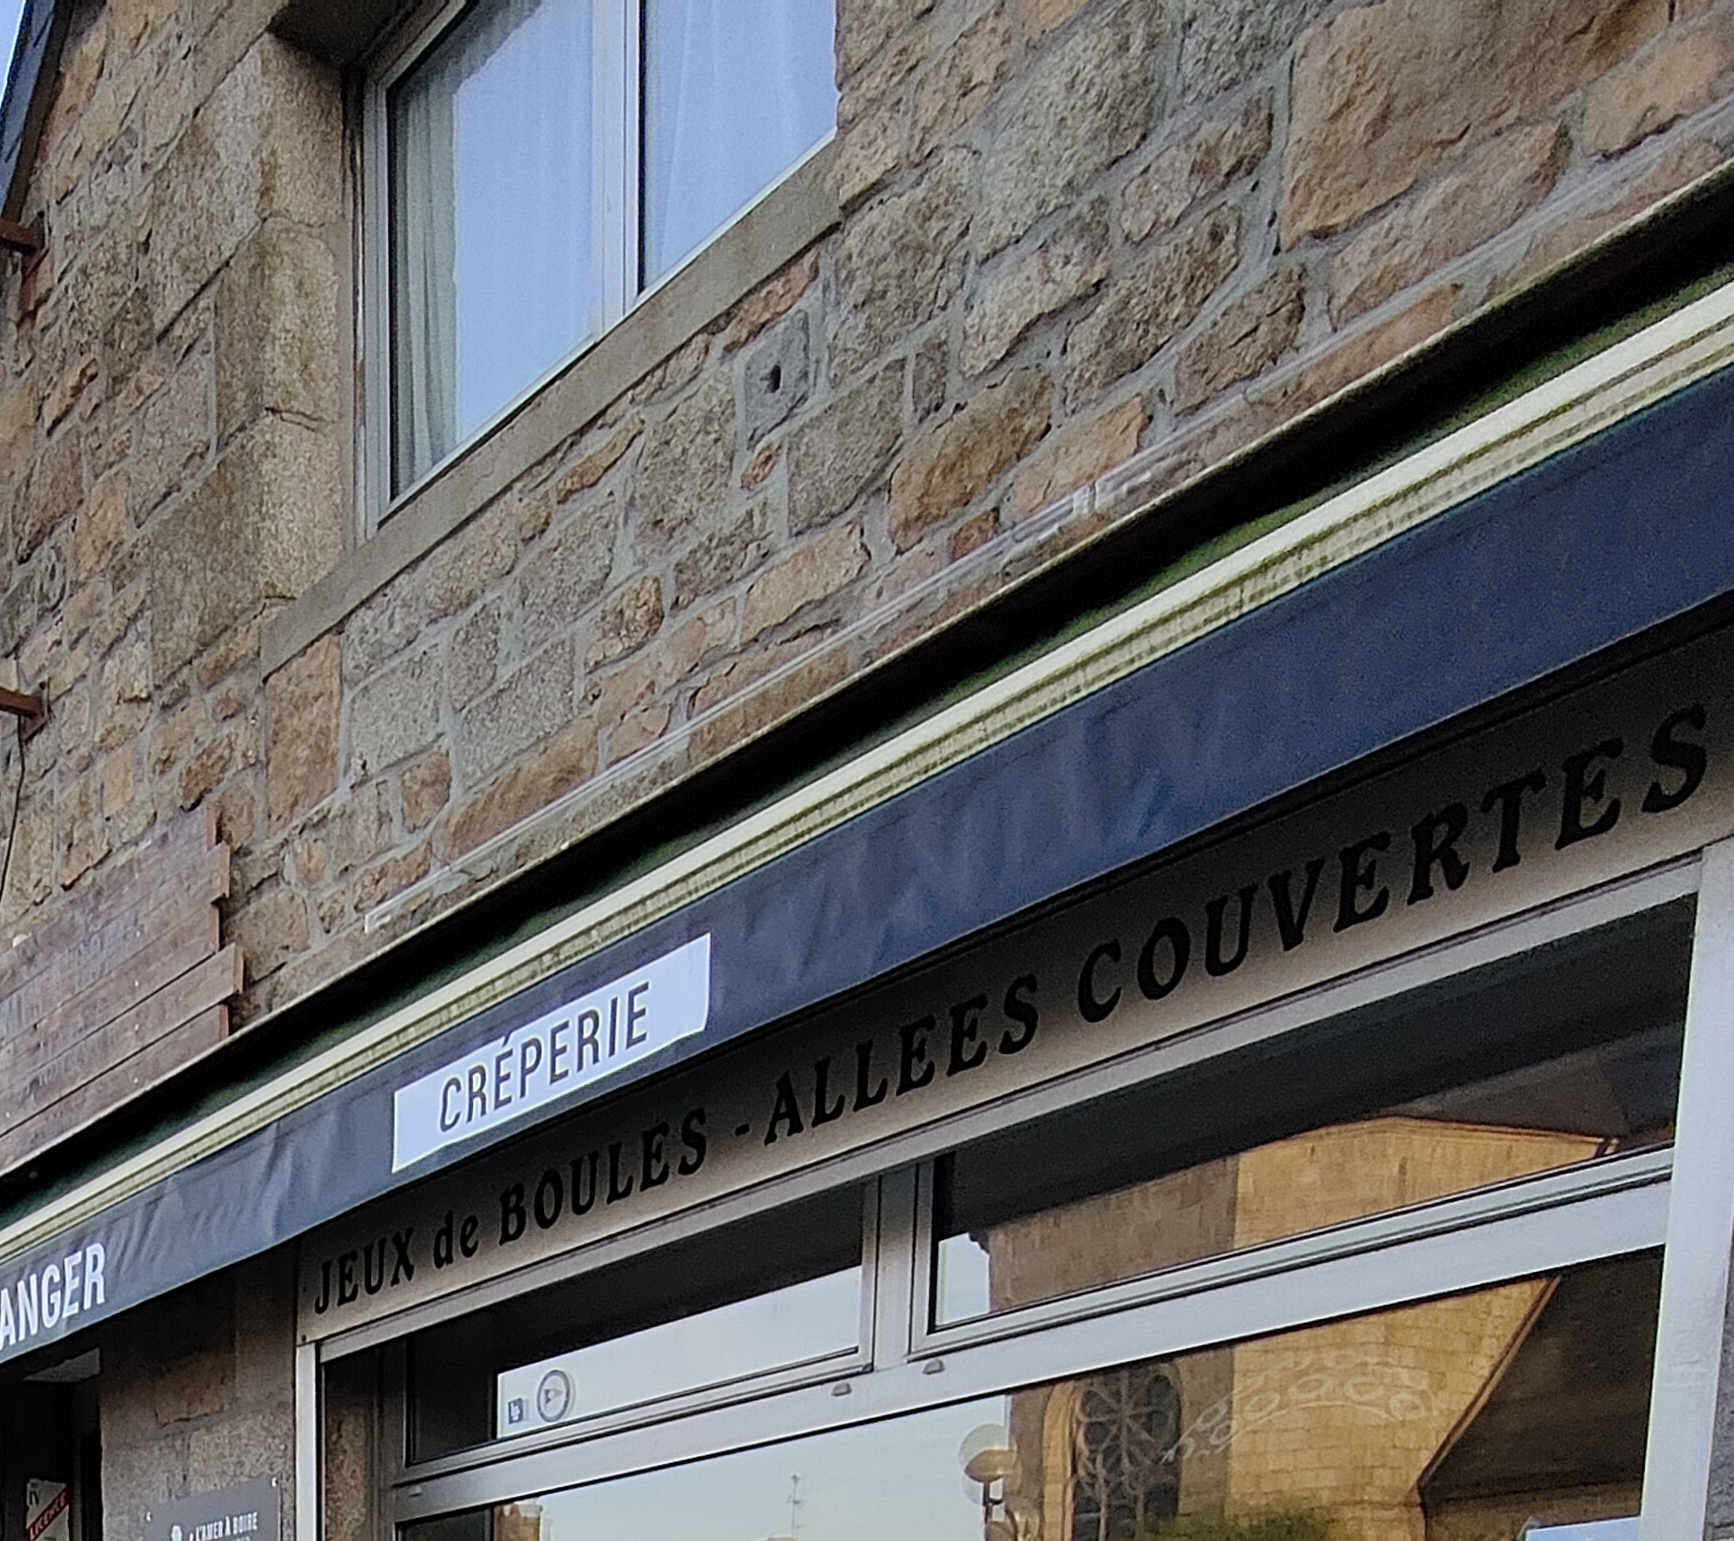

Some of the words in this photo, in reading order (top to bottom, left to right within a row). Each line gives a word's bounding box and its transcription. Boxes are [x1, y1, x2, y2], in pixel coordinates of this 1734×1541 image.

[313, 1224, 415, 1316] JEUX
[432, 1203, 479, 1268] de
[497, 1106, 708, 1248] BOULES
[764, 973, 1040, 1147] ALLEES
[1076, 703, 1709, 1024] COUVERTES
[439, 980, 651, 1133] CRÉPERIE
